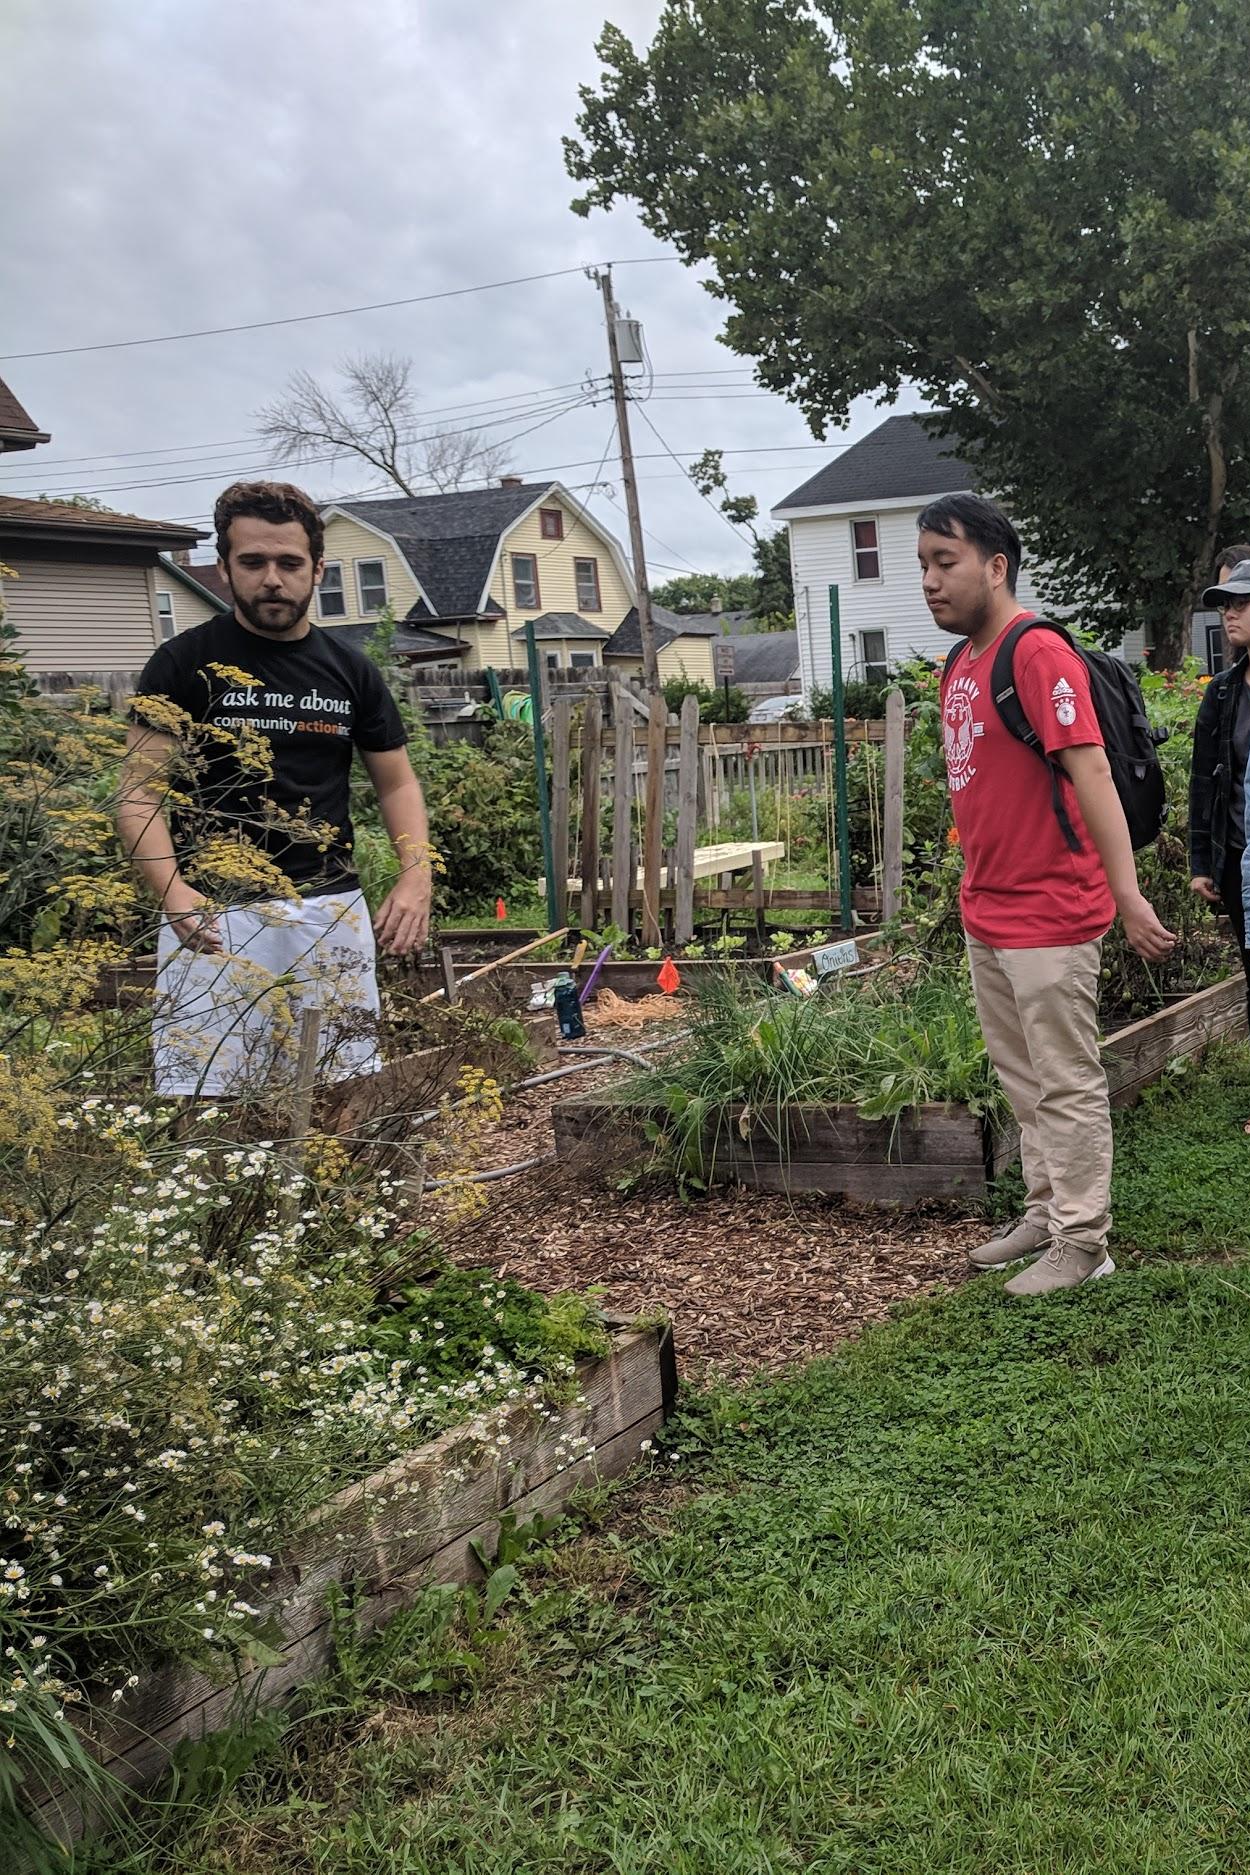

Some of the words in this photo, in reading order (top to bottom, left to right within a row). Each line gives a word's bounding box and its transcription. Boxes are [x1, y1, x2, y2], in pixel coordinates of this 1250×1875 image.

[222, 685, 259, 707] ask
[264, 691, 295, 709] me
[300, 688, 352, 715] about
